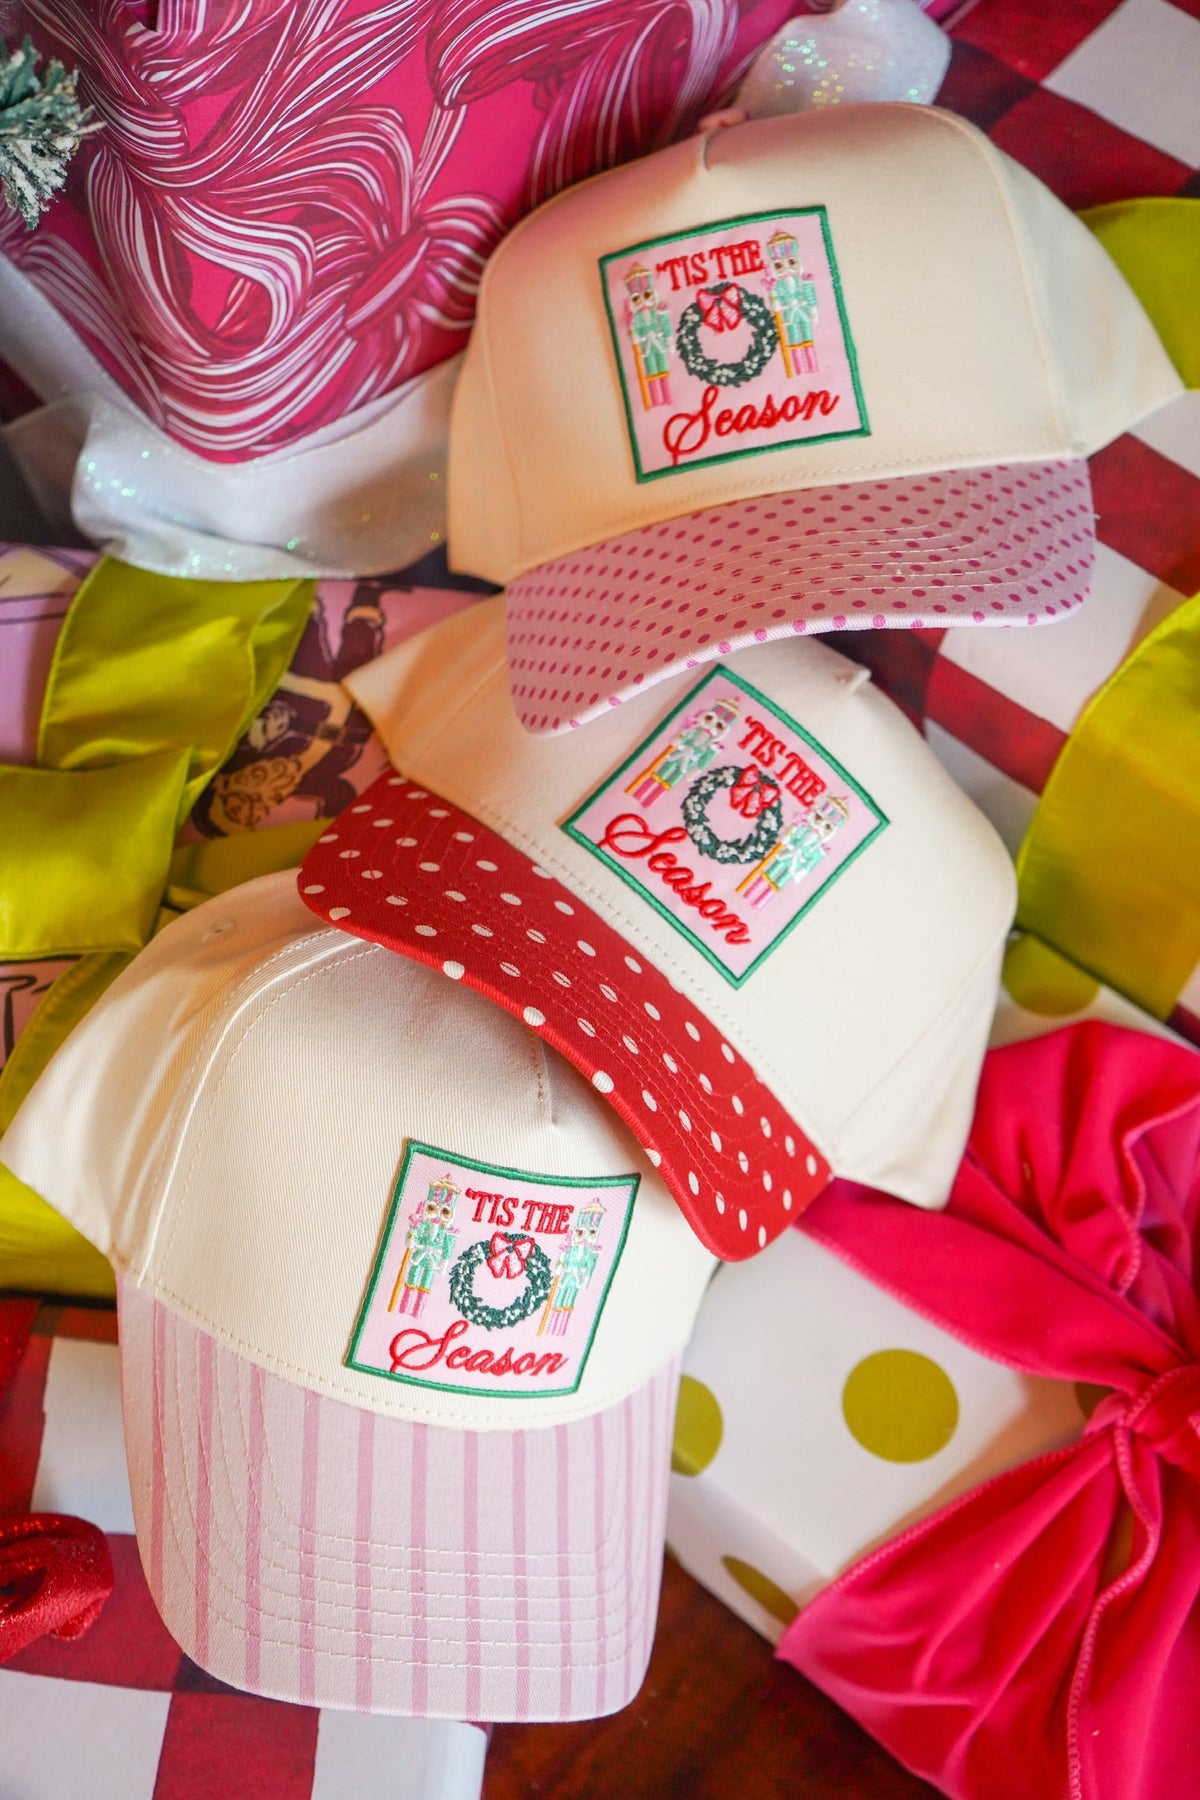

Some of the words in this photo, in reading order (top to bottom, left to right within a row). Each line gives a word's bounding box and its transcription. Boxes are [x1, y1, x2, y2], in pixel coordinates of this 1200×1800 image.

[711, 240, 765, 280] THE
[663, 385, 839, 465] Season
[776, 750, 828, 808] THE
[596, 813, 751, 945] Season
[521, 1200, 575, 1235] THE
[389, 1320, 569, 1376] Season
